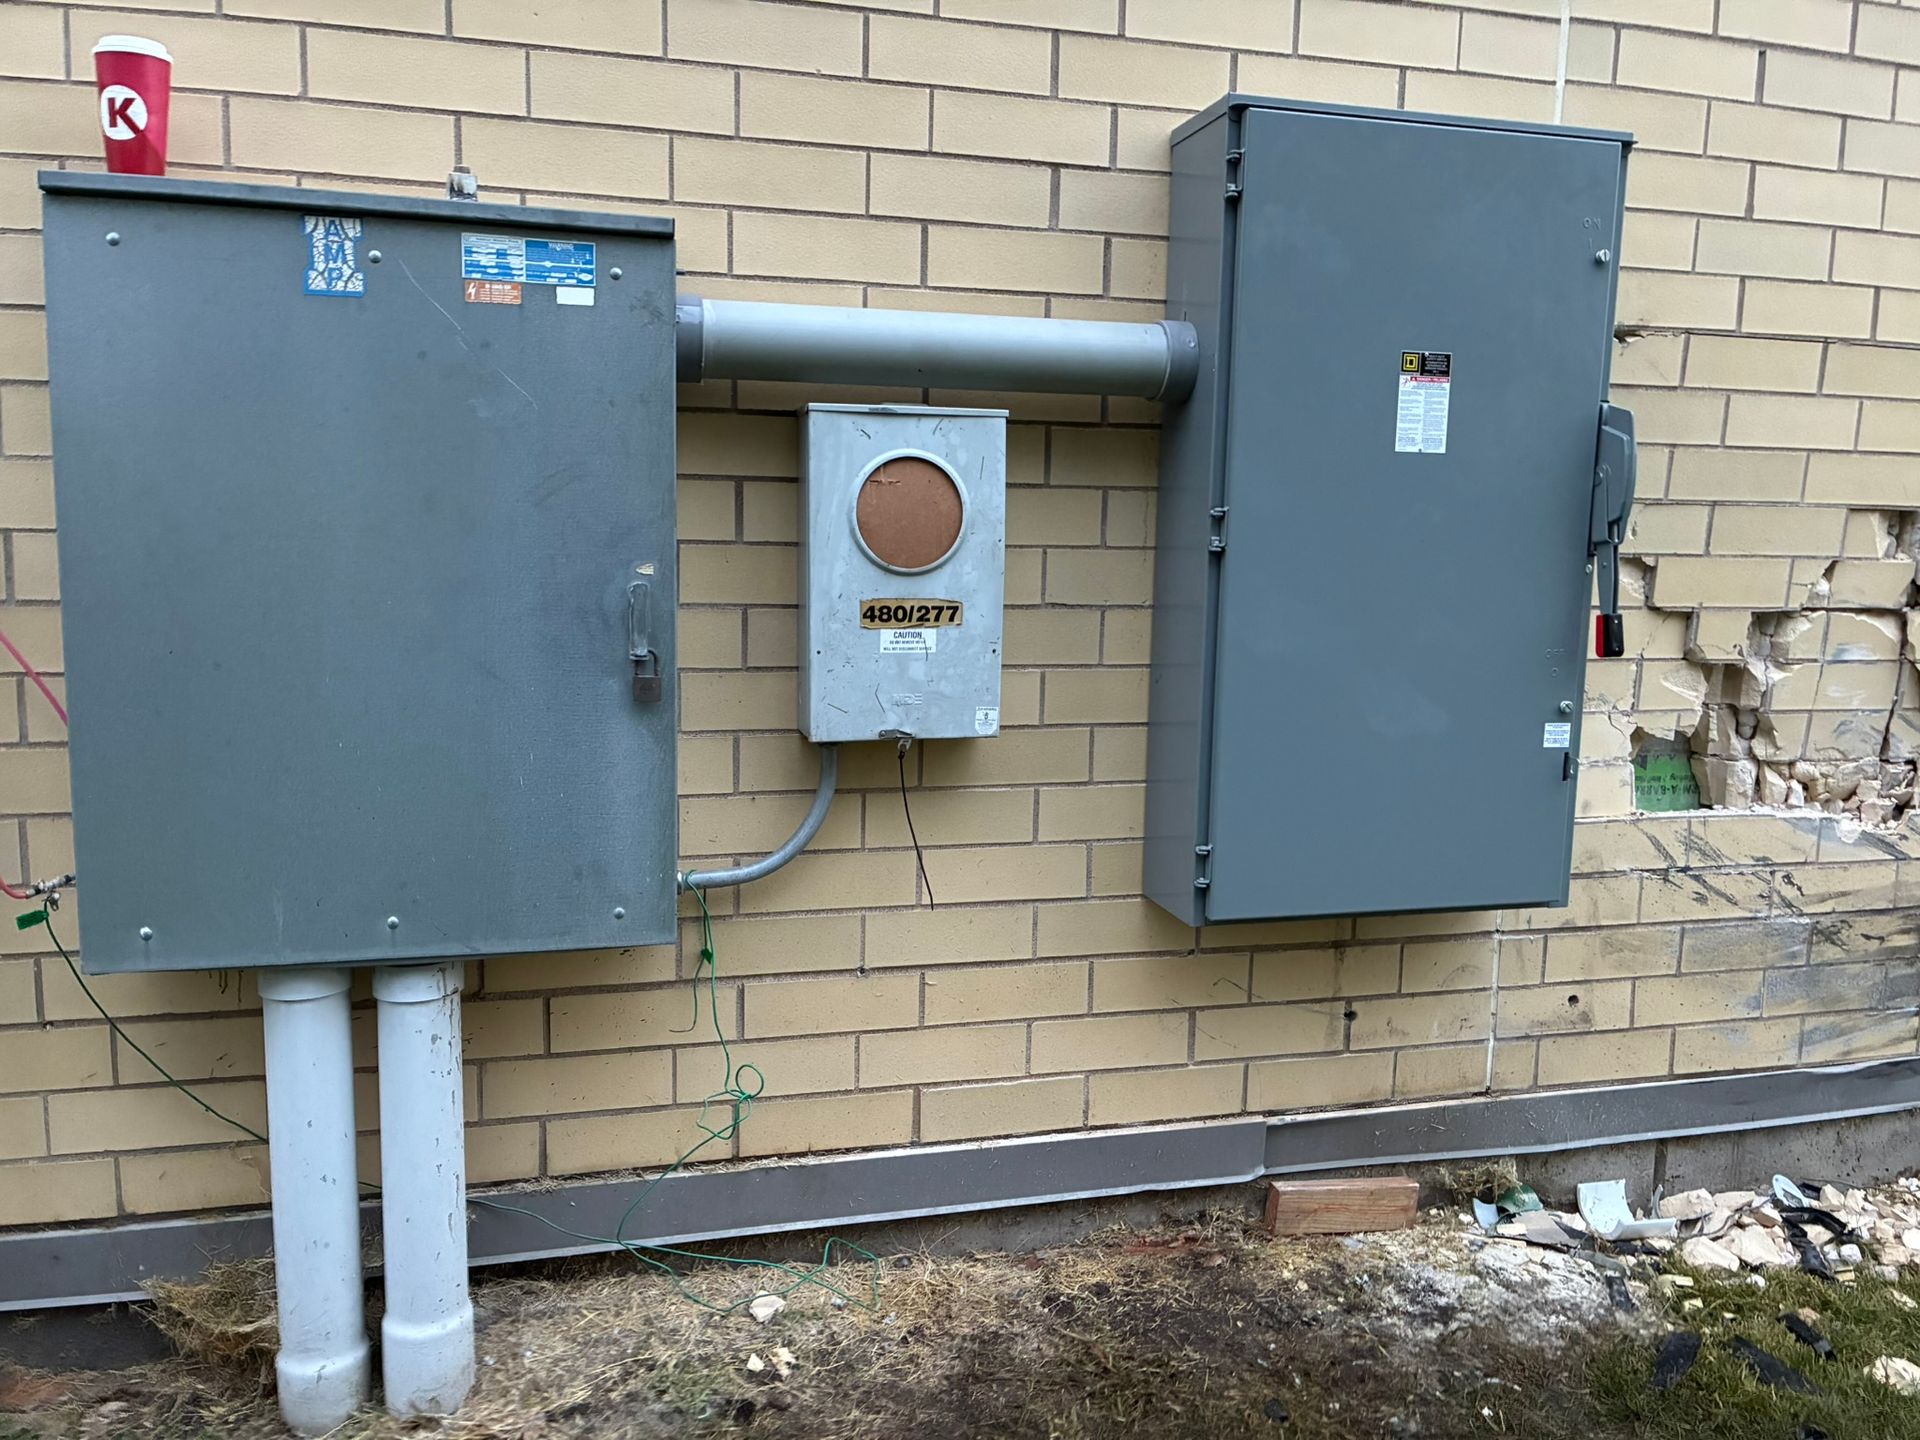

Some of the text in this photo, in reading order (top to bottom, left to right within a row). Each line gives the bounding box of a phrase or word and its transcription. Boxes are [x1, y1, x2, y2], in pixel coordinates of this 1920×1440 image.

[107, 97, 141, 136] K
[862, 605, 960, 623] 480/277
[893, 631, 922, 639] CAUTION
